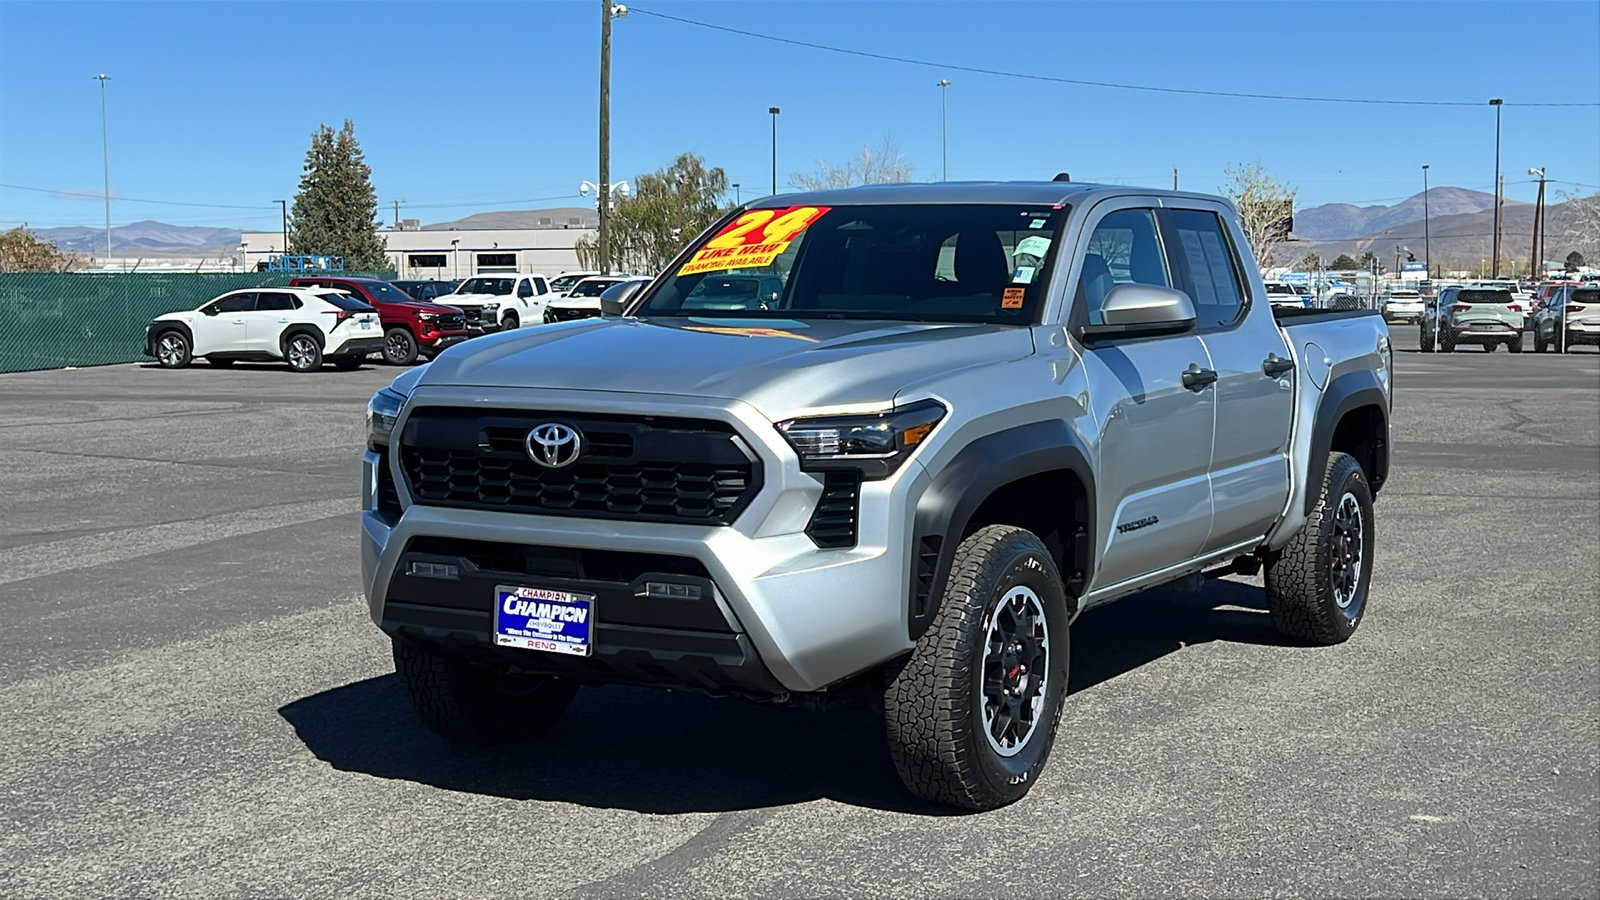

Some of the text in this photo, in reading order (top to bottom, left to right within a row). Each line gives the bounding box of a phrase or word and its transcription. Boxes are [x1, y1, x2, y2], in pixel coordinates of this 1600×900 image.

[707, 207, 819, 248] 24
[699, 243, 781, 260] LIKE NEW
[681, 255, 771, 273] FINANCING AVAILABLE
[522, 589, 567, 601] CHAMPION
[503, 595, 588, 624] CHAMPION
[529, 621, 562, 630] CHEVROLET
[527, 640, 556, 650] RENO
